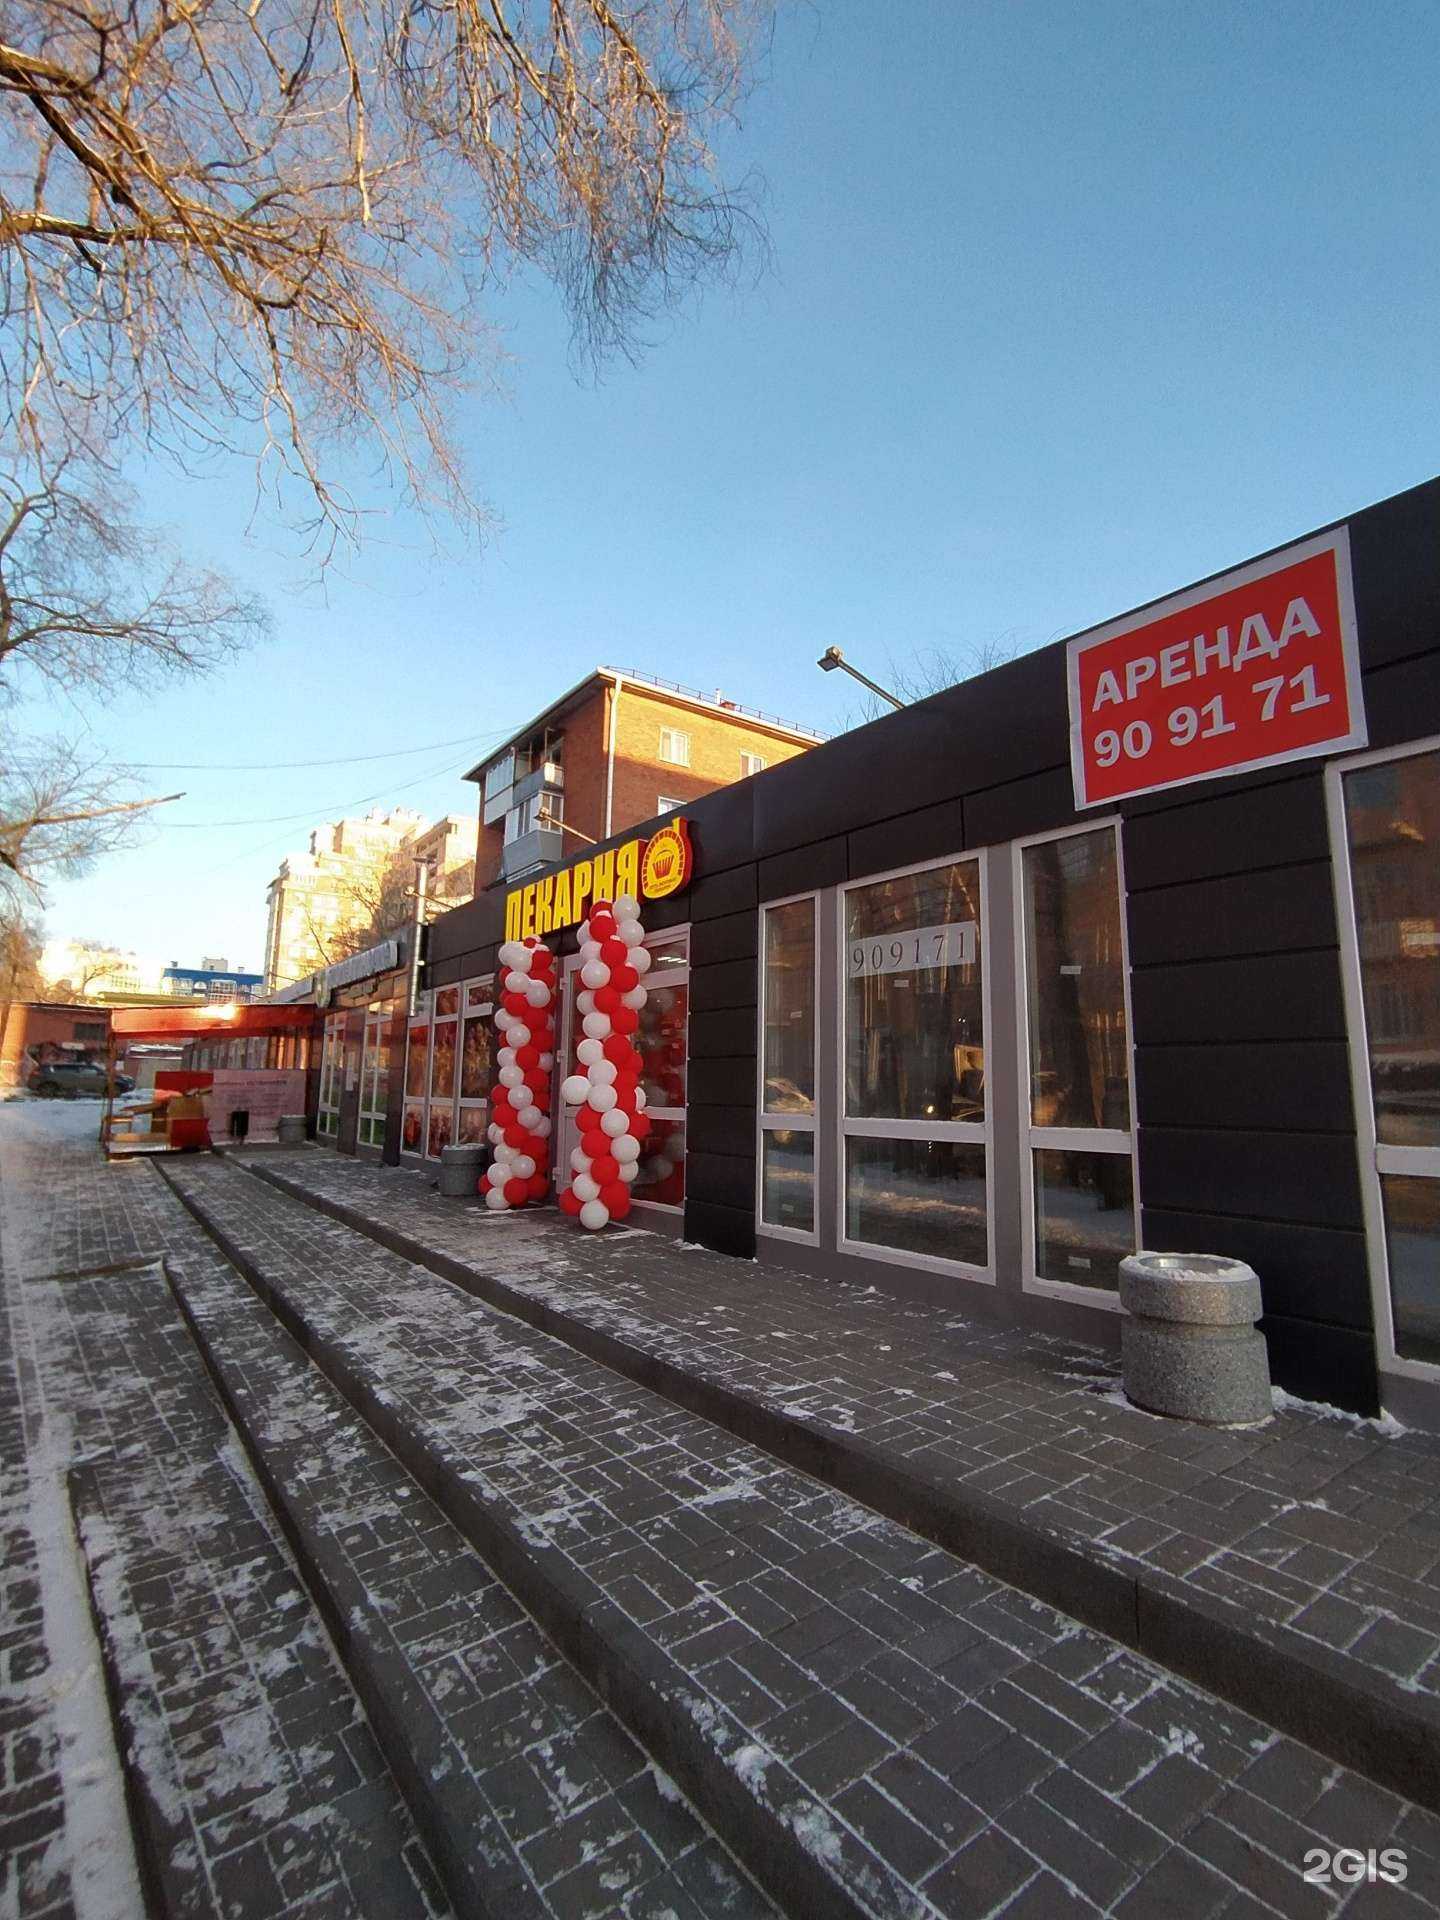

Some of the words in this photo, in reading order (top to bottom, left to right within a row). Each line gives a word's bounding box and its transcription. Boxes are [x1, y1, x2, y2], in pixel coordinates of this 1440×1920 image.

[1092, 597, 1321, 712] АРЕНДА
[1093, 719, 1152, 767] 90
[1167, 694, 1236, 746] 91
[1252, 664, 1330, 721] 71
[505, 839, 639, 944] ПЕКАРНЯ
[853, 931, 964, 973] 909171
